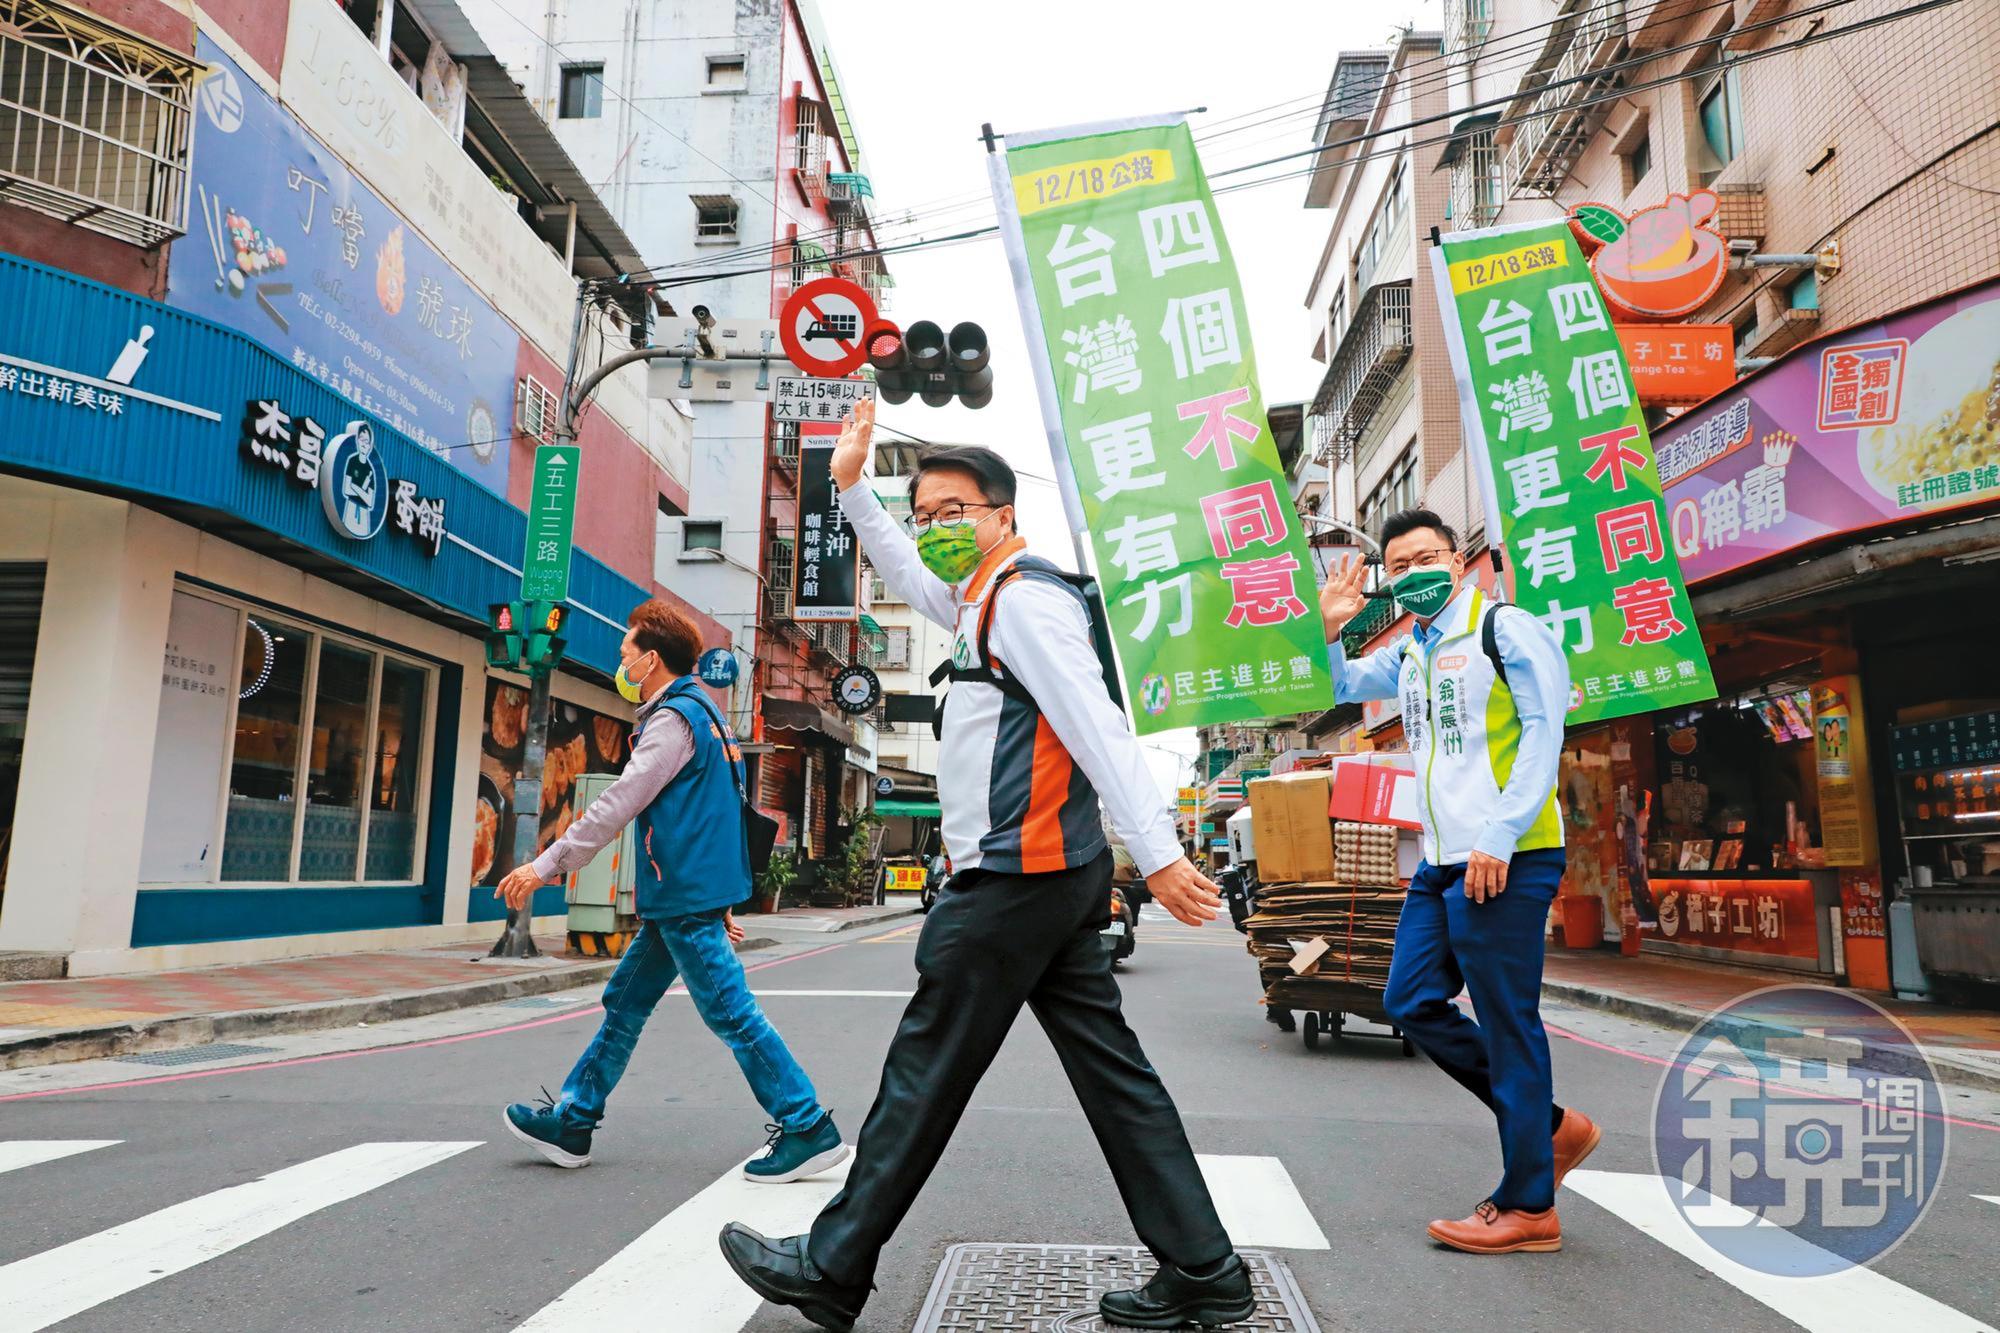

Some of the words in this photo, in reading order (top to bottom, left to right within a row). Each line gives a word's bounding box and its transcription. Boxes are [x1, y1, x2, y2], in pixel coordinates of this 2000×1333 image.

[1036, 168, 1105, 204] 12/18
[1109, 155, 1156, 190] 公投
[287, 165, 368, 270] 叮噹
[415, 276, 474, 361] 號球
[1466, 256, 1521, 287] 12/18
[1523, 246, 1557, 270] 公投
[298, 292, 323, 320] TEL:
[324, 311, 382, 361] 02-2298-4959
[384, 355, 409, 382] Phone:
[1634, 341, 1723, 361] 子工坊
[343, 355, 365, 382] Open
[366, 371, 386, 394] time:
[780, 381, 871, 400] 禁止15噸以上
[1630, 364, 1662, 376] range
[1664, 364, 1686, 374] Tea
[1830, 353, 1861, 414] 全國
[1859, 358, 1892, 420] 獨創
[778, 400, 851, 419] 大貨車進
[807, 438, 833, 446] Sunny
[1046, 223, 1194, 643] 台灣更有力
[251, 400, 325, 489] 杰哥
[394, 479, 446, 557] 蛋餅
[1477, 299, 1594, 655] 台灣更有力
[1897, 464, 2000, 510] 註冊證號
[536, 467, 566, 563] 五工三路
[530, 566, 563, 582] Wugong
[802, 513, 822, 597] 咖啡輕食館
[528, 584, 541, 596] 3rd
[542, 583, 555, 597] Rd
[1174, 655, 1313, 697] 民主進步黨
[1176, 695, 1215, 706] Democratic
[1216, 689, 1258, 702] Progressive
[1258, 686, 1278, 695] Party
[1278, 685, 1287, 693] of
[1289, 682, 1315, 692] Taiwan
[1584, 660, 1697, 697] 民主進步黨
